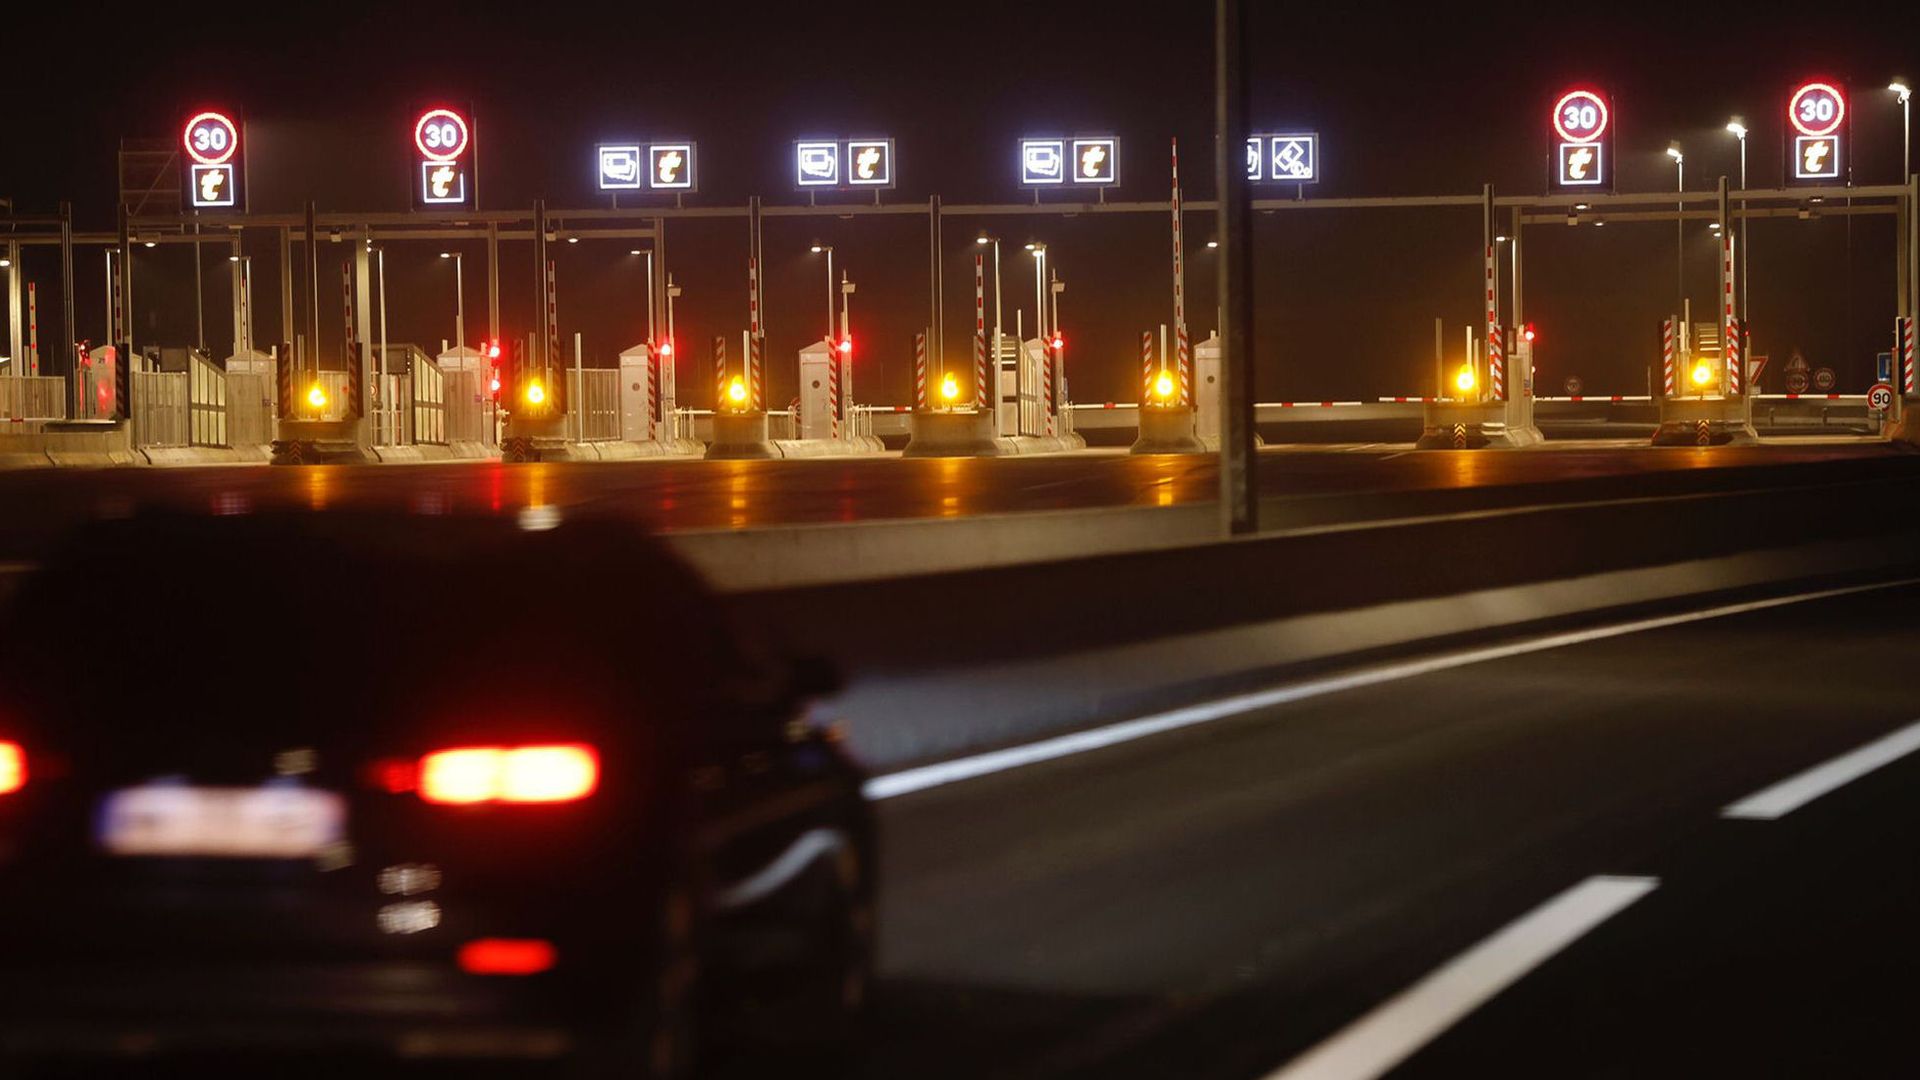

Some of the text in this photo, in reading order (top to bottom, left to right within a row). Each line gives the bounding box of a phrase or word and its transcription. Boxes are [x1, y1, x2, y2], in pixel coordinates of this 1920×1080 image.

[1563, 106, 1596, 129] 30
[1800, 99, 1833, 122] 30
[194, 127, 226, 151] 30
[425, 125, 457, 147] 30
[1873, 393, 1891, 404] 90
